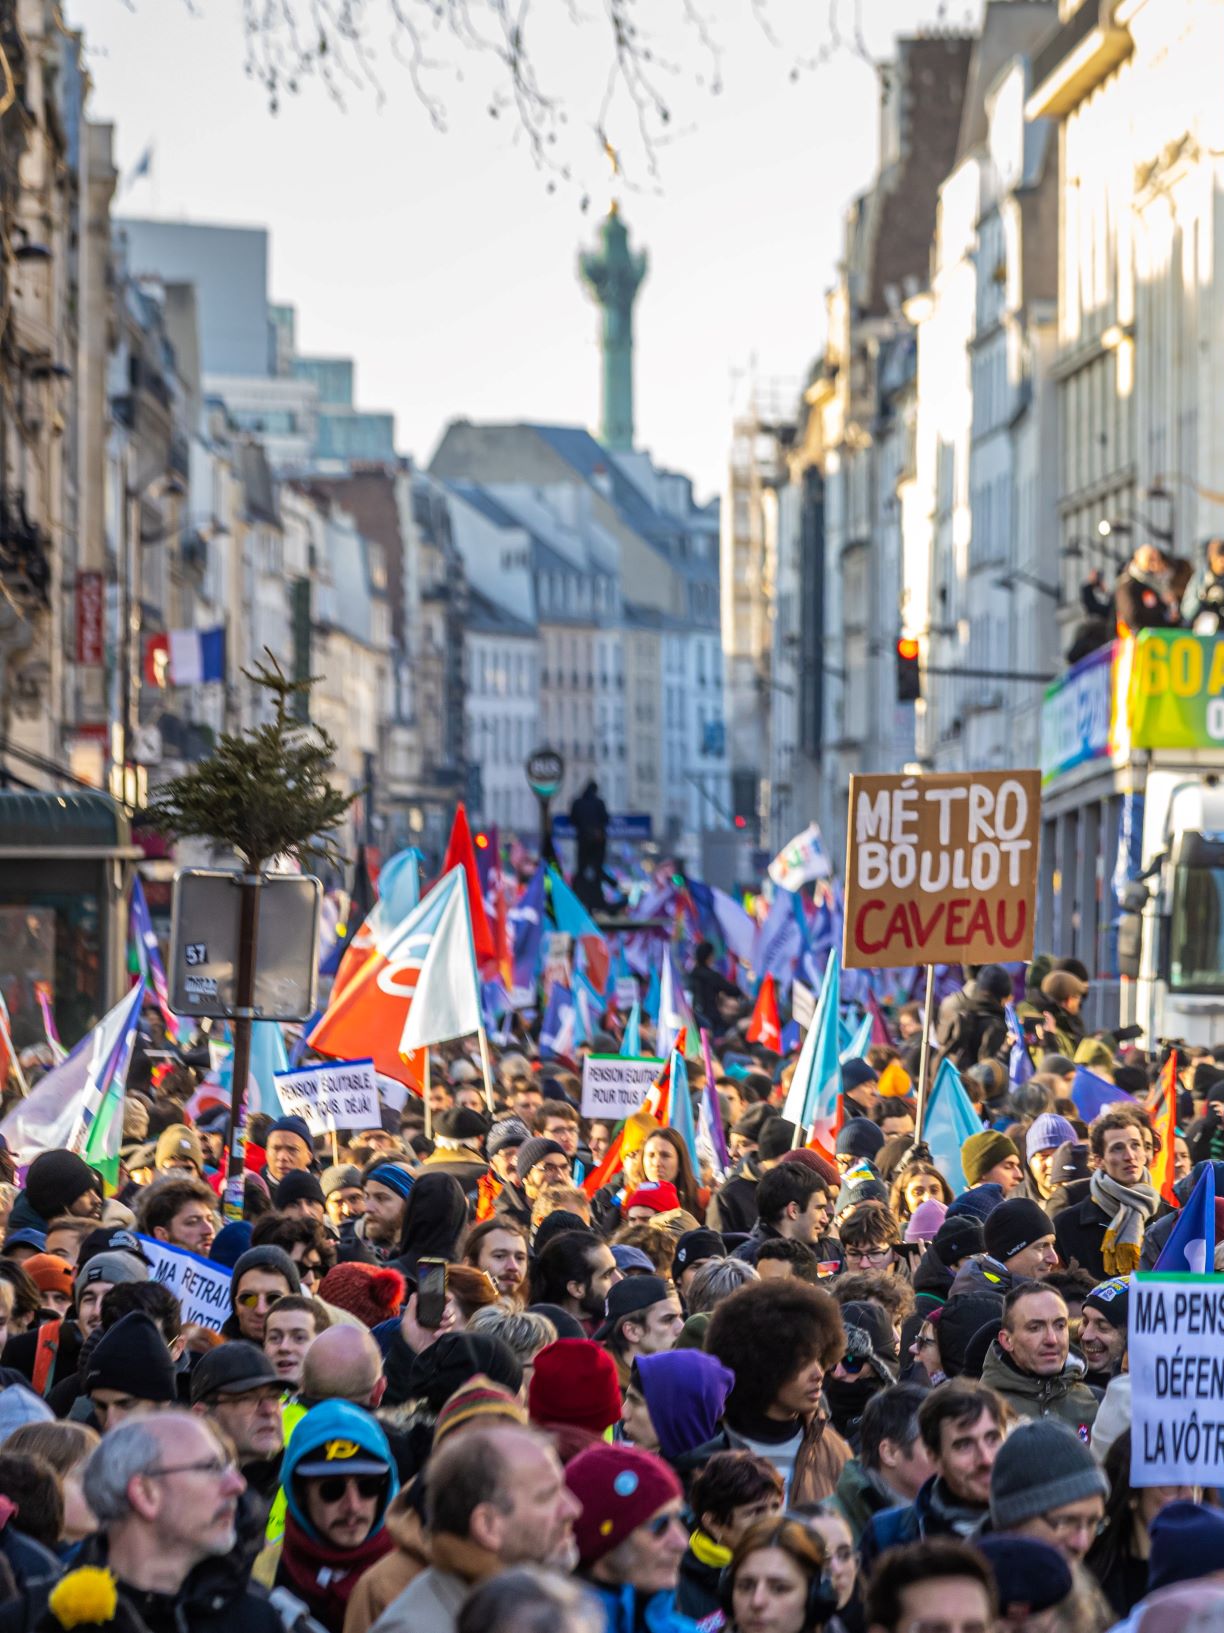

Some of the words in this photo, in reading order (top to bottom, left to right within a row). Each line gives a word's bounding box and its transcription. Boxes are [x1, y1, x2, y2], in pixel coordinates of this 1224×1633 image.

[1141, 637, 1203, 697] 60
[856, 777, 1029, 845] MÉTRO
[857, 839, 1032, 893] BOULOT
[855, 898, 1026, 955] CAVEAU
[154, 1258, 177, 1284] MA
[1135, 1292, 1168, 1334] MA
[1143, 1420, 1167, 1466] LA
